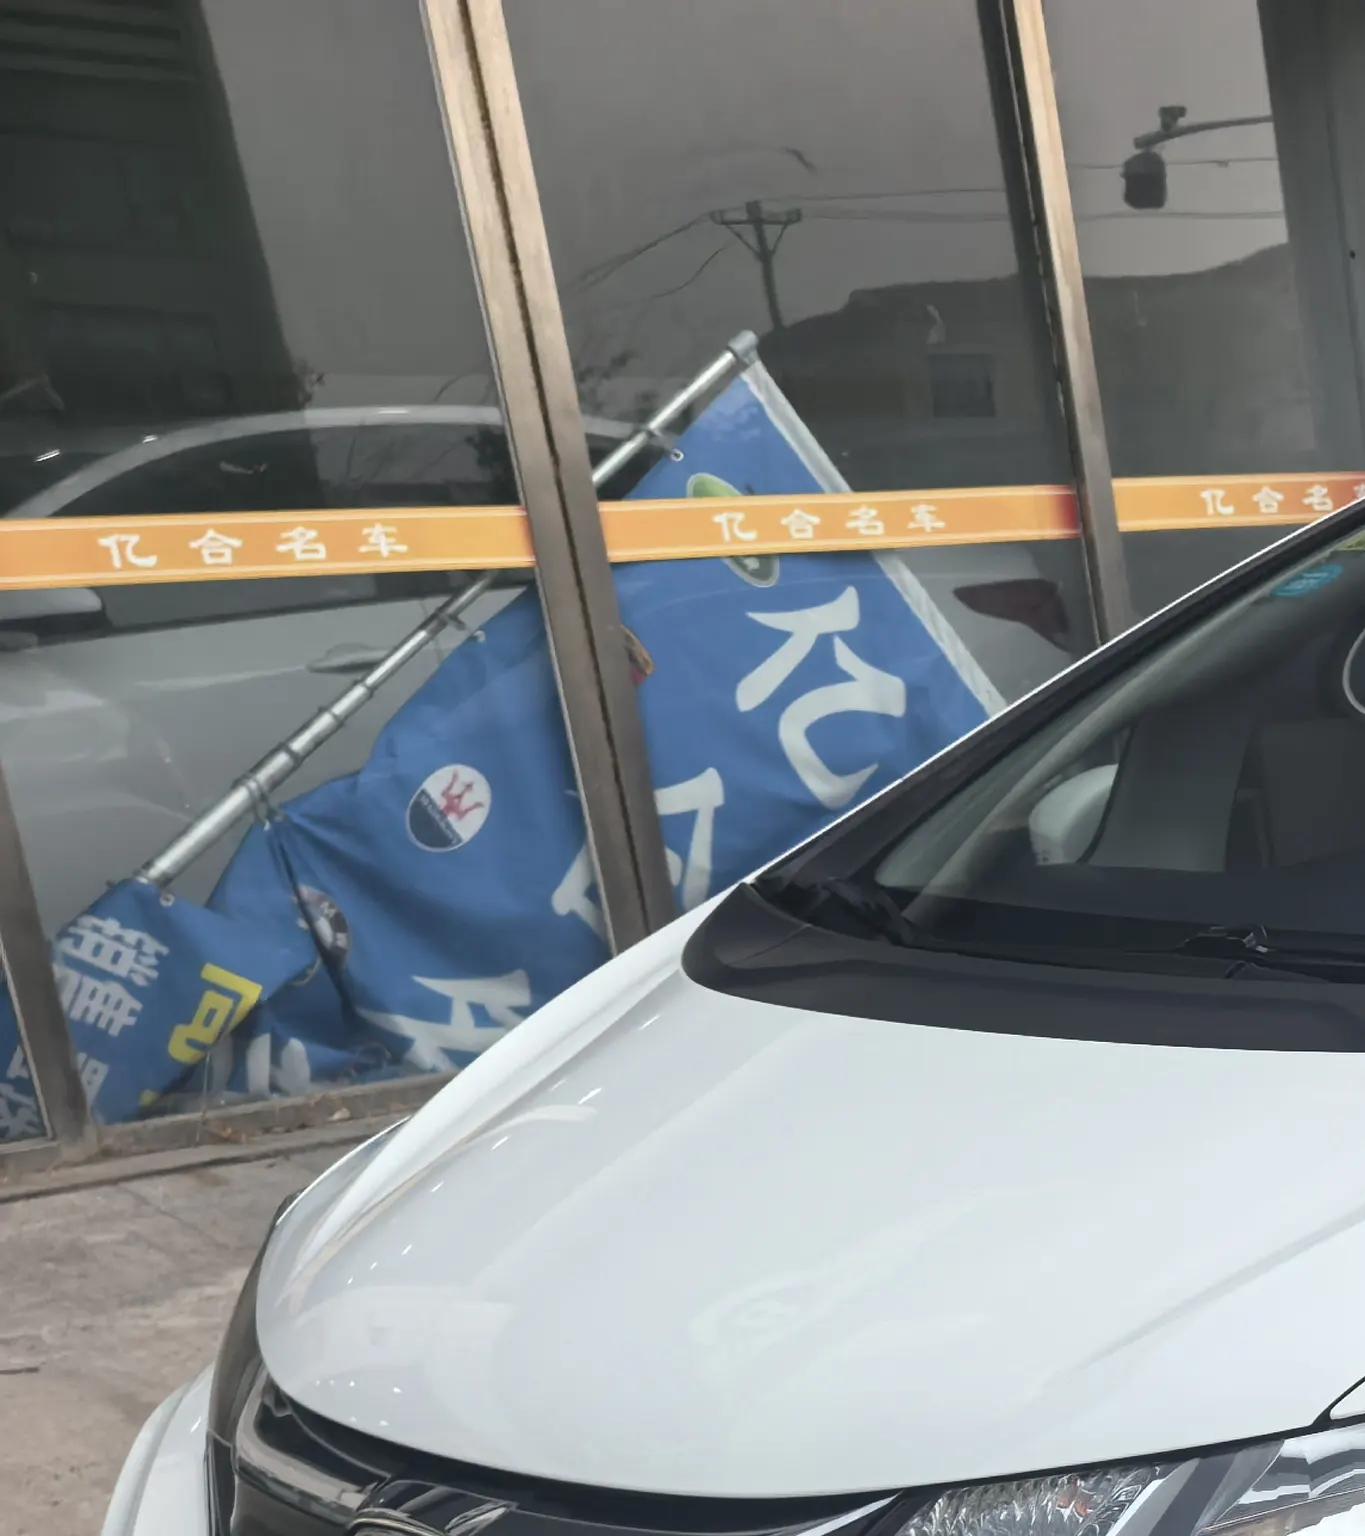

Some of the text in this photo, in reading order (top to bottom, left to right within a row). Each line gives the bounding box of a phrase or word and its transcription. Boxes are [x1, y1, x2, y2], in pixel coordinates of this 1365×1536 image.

[97, 523, 410, 570] 亿合名车
[711, 504, 948, 545] 亿合名车
